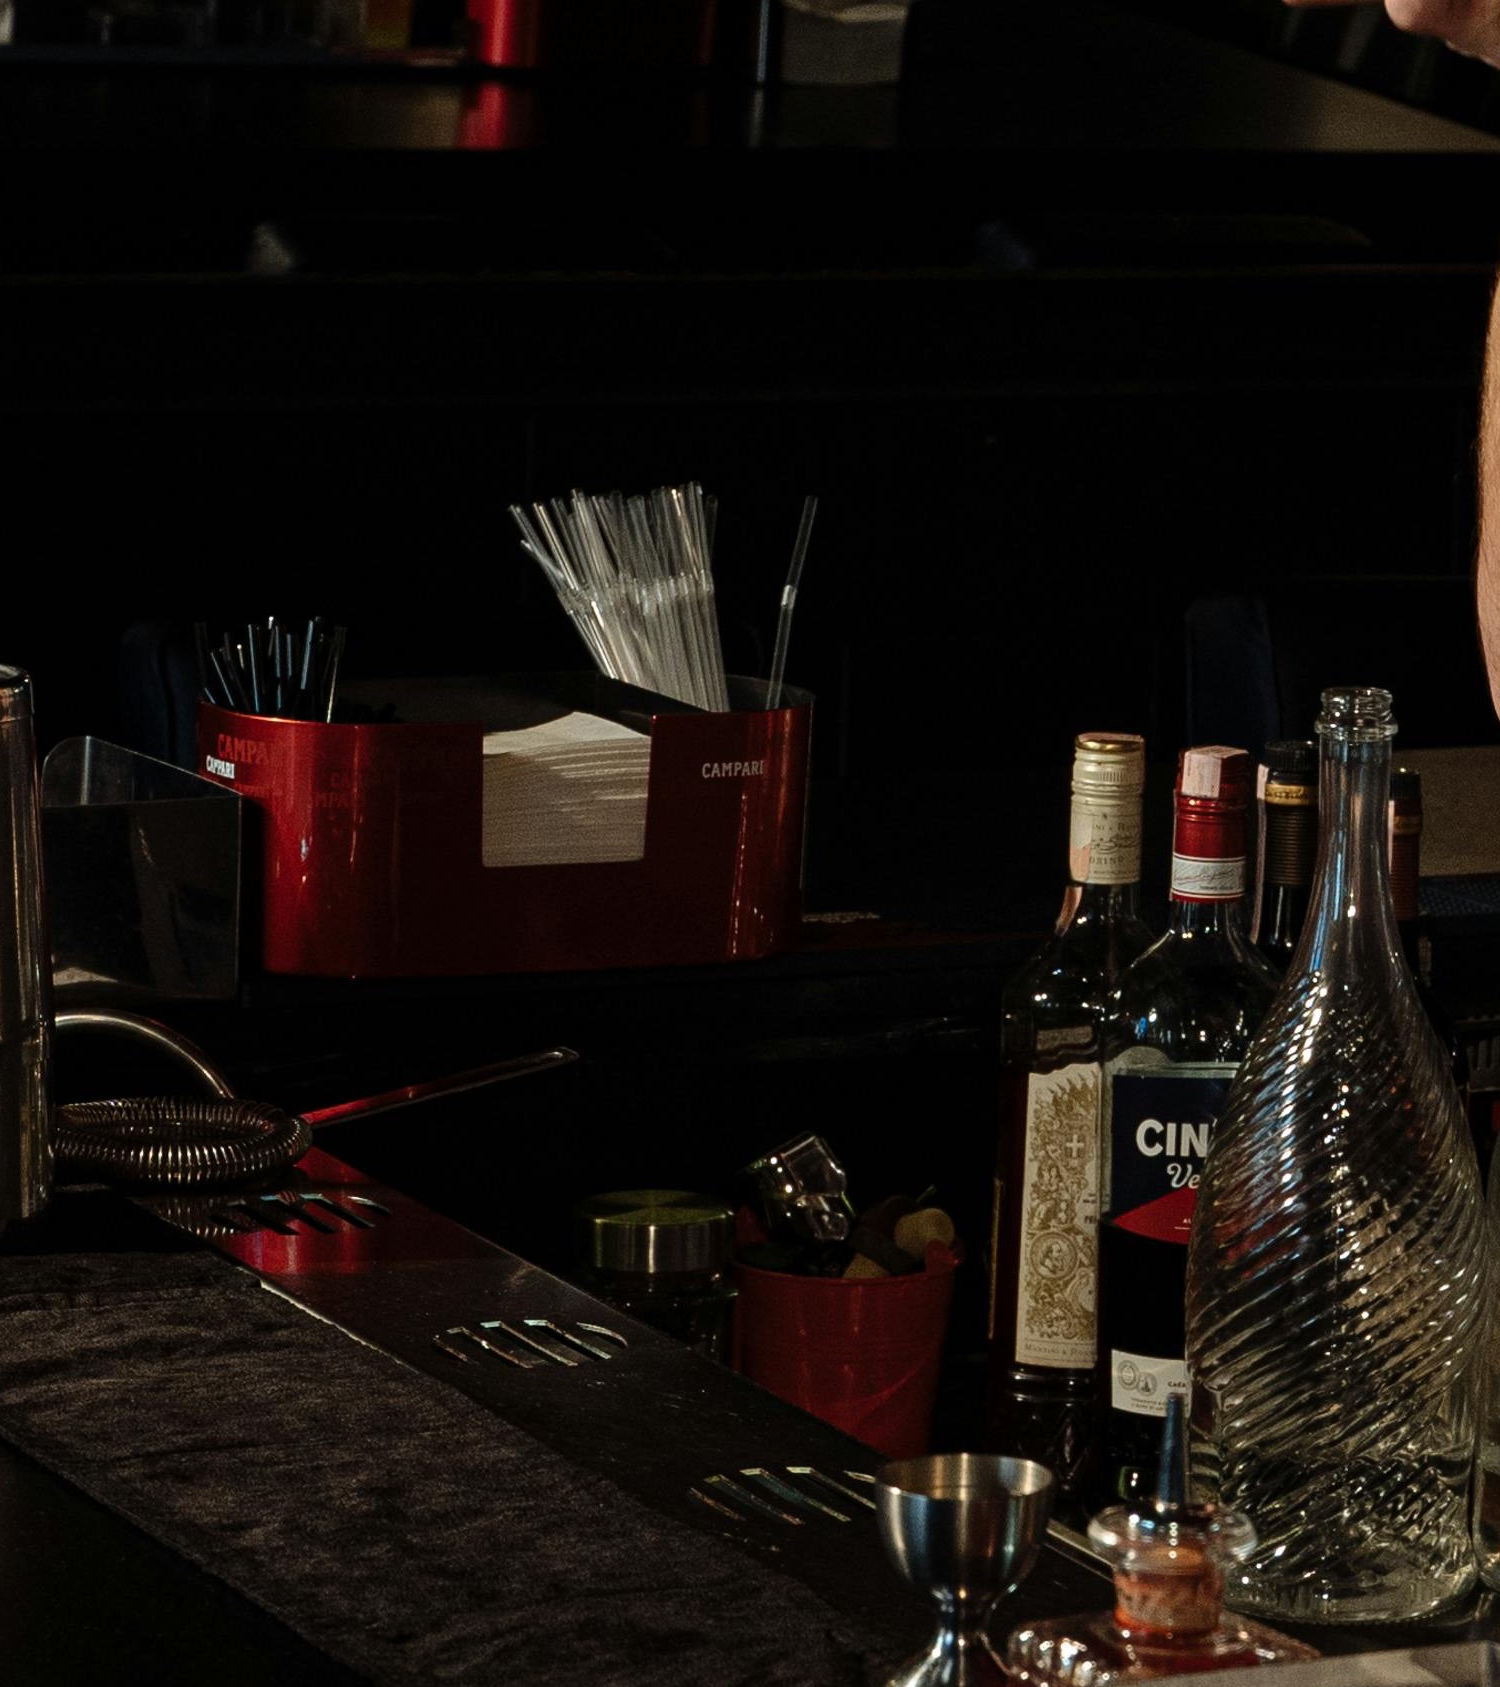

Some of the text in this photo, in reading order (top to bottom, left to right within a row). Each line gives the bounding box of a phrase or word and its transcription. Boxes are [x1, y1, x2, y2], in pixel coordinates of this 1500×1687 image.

[701, 760, 764, 779] CAMPARI
[1135, 1118, 1210, 1158] CIN
[1166, 1162, 1201, 1190] Ve
